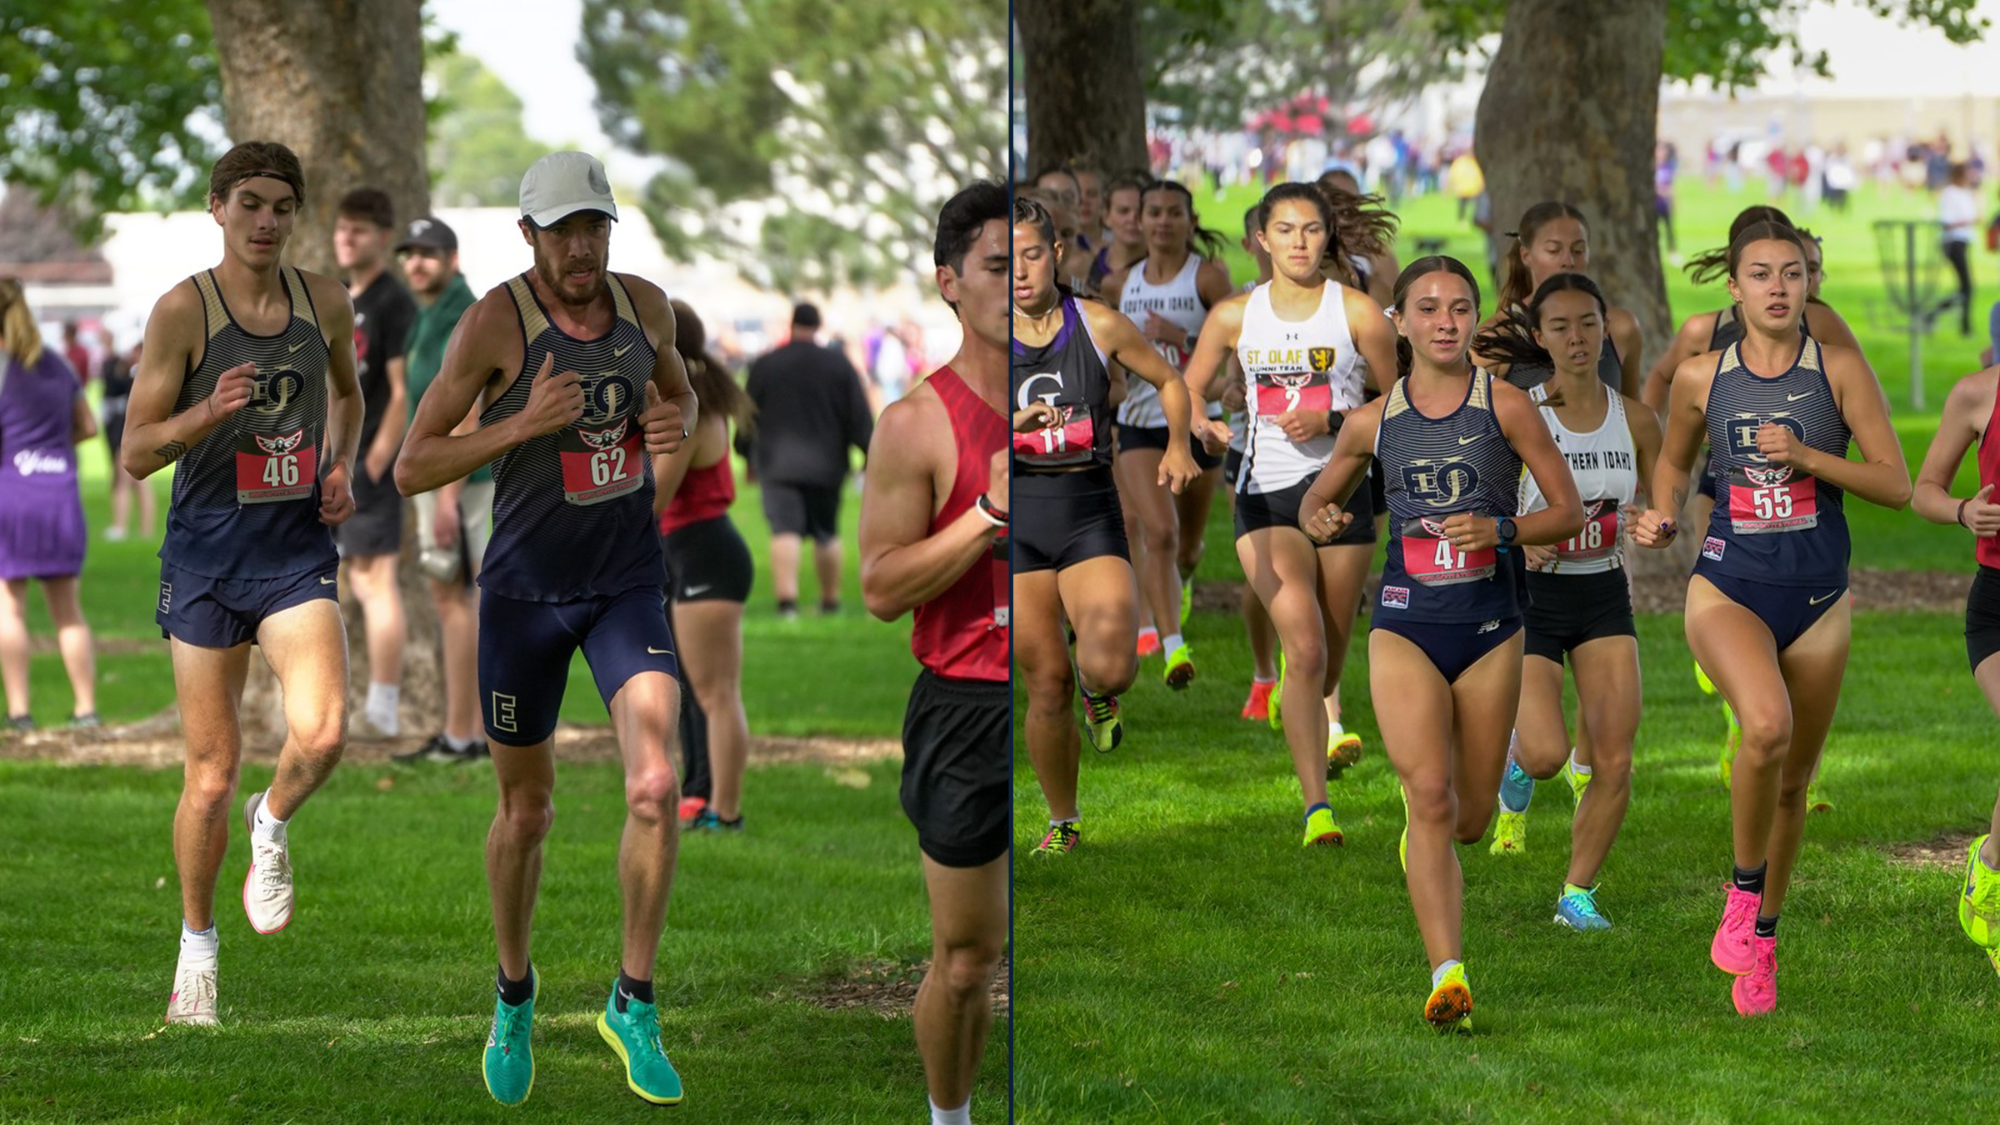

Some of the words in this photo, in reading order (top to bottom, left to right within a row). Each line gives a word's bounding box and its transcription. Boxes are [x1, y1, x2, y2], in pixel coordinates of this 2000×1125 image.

[1246, 349, 1264, 364] ST.
[1268, 349, 1303, 364] OLAF
[1284, 389, 1301, 412] 2
[1039, 426, 1066, 454] 11
[262, 454, 300, 487] 46
[590, 446, 628, 487] 62
[1564, 452, 1599, 470] THERN
[1753, 486, 1793, 520] 55
[156, 580, 172, 615] E
[492, 690, 518, 733] E
